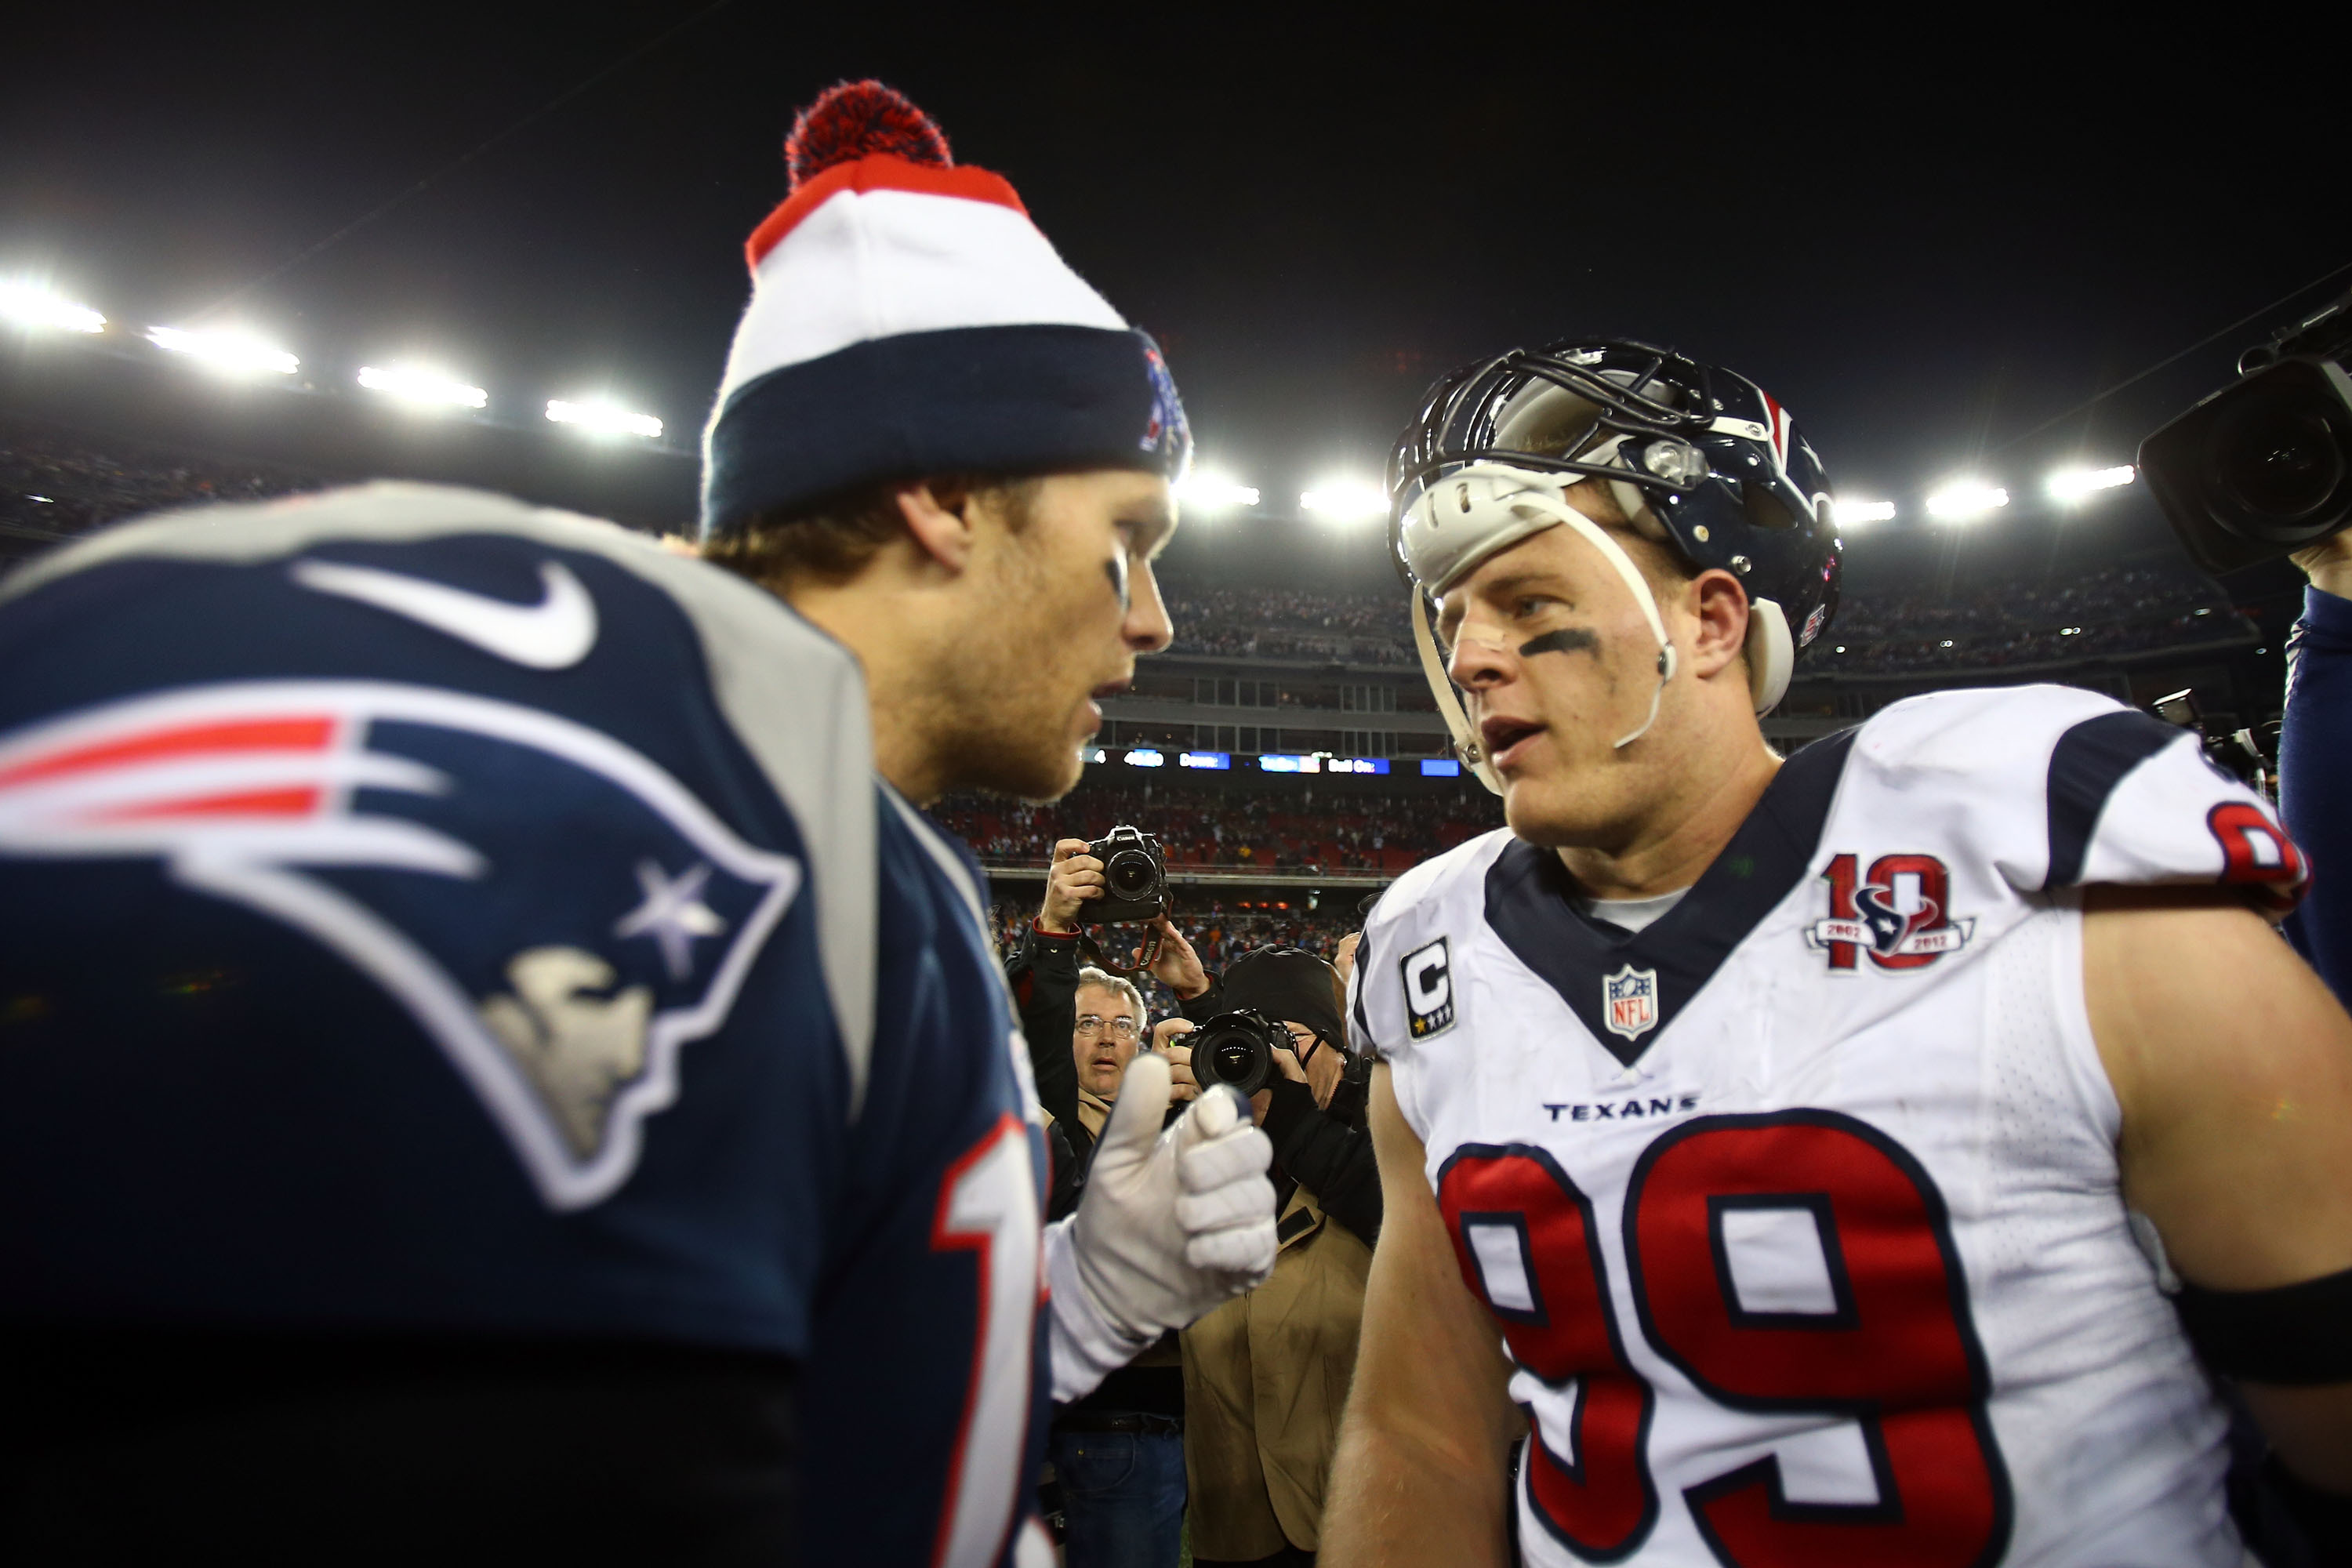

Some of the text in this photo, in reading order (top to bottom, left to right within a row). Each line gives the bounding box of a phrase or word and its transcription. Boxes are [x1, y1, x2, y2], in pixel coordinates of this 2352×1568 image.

[1820, 854, 1950, 969] 10
[1827, 924, 1861, 938] 2002
[1912, 935, 1947, 950] 2012
[1140, 941, 1157, 966] Canon
[1406, 942, 1450, 1016] C
[1613, 998, 1651, 1027] NFL
[1543, 1095, 1700, 1123] TEXANS
[1437, 1108, 2013, 1568] 99
